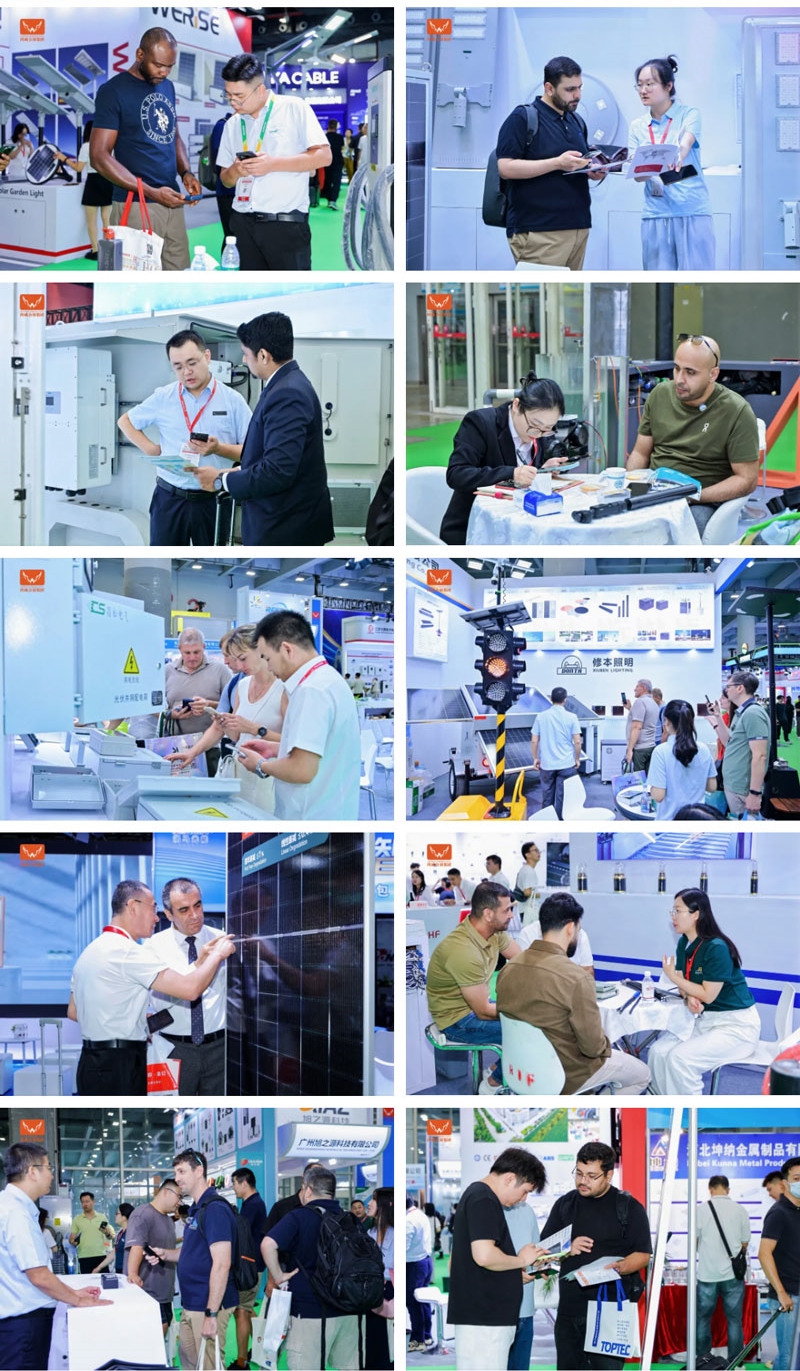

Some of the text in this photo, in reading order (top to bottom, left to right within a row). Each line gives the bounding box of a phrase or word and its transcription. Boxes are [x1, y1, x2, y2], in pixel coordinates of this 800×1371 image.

[29, 189, 44, 198] Light
[592, 657, 634, 668] 修本照明
[298, 1138, 380, 1149] 广州旭之源科技有限公司
[711, 1159, 737, 1167] Kunna
[739, 1159, 762, 1167] Metal
[600, 1341, 631, 1356] TOPTEC
